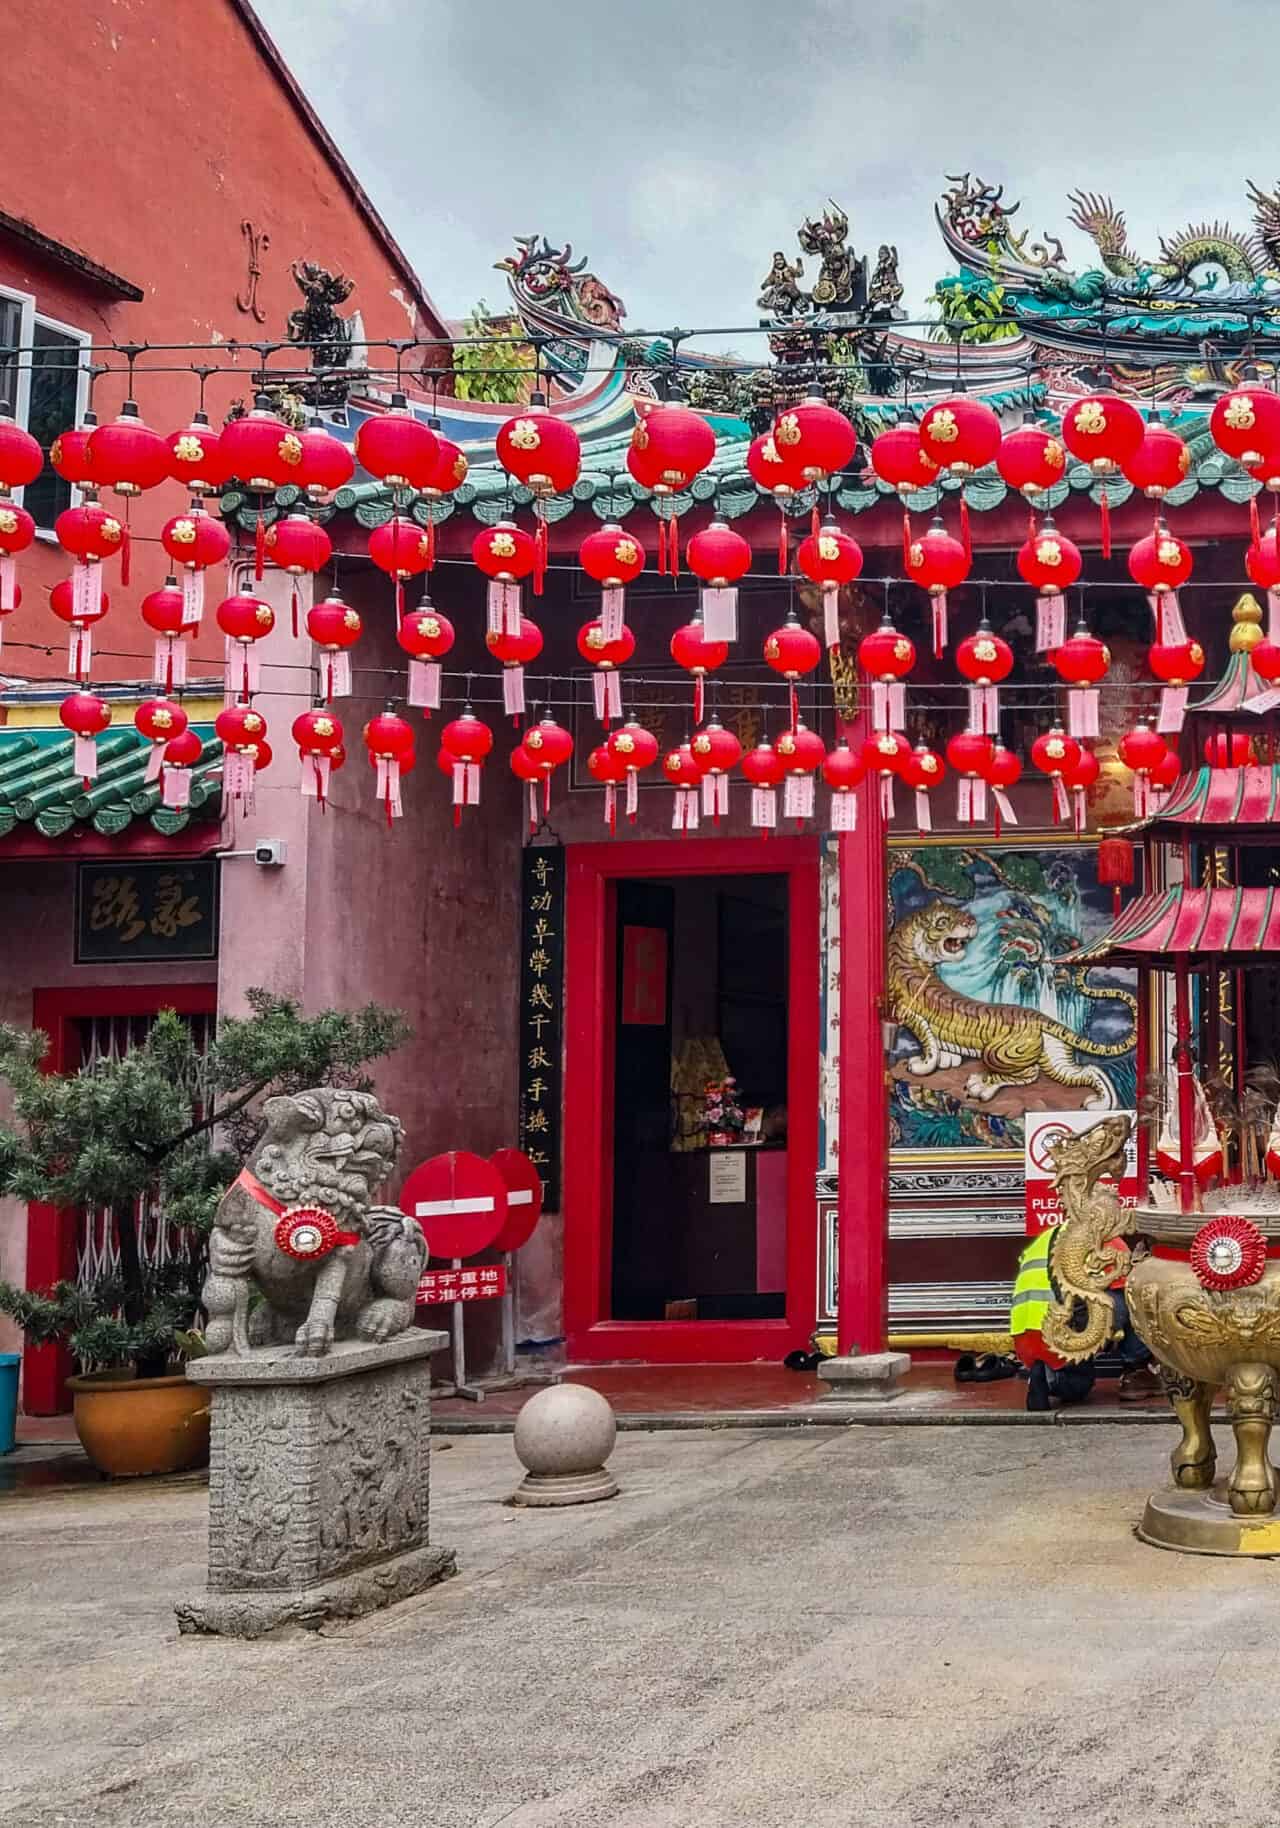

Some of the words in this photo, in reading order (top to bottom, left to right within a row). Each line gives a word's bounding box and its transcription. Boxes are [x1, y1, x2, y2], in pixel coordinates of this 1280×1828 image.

[926, 408, 959, 442] 福
[1074, 402, 1107, 434] 福
[1223, 396, 1256, 430] 福
[174, 435, 205, 462] 福
[508, 420, 541, 450] 福
[1031, 1198, 1064, 1210] PLEA
[1036, 1213, 1068, 1226] YO
